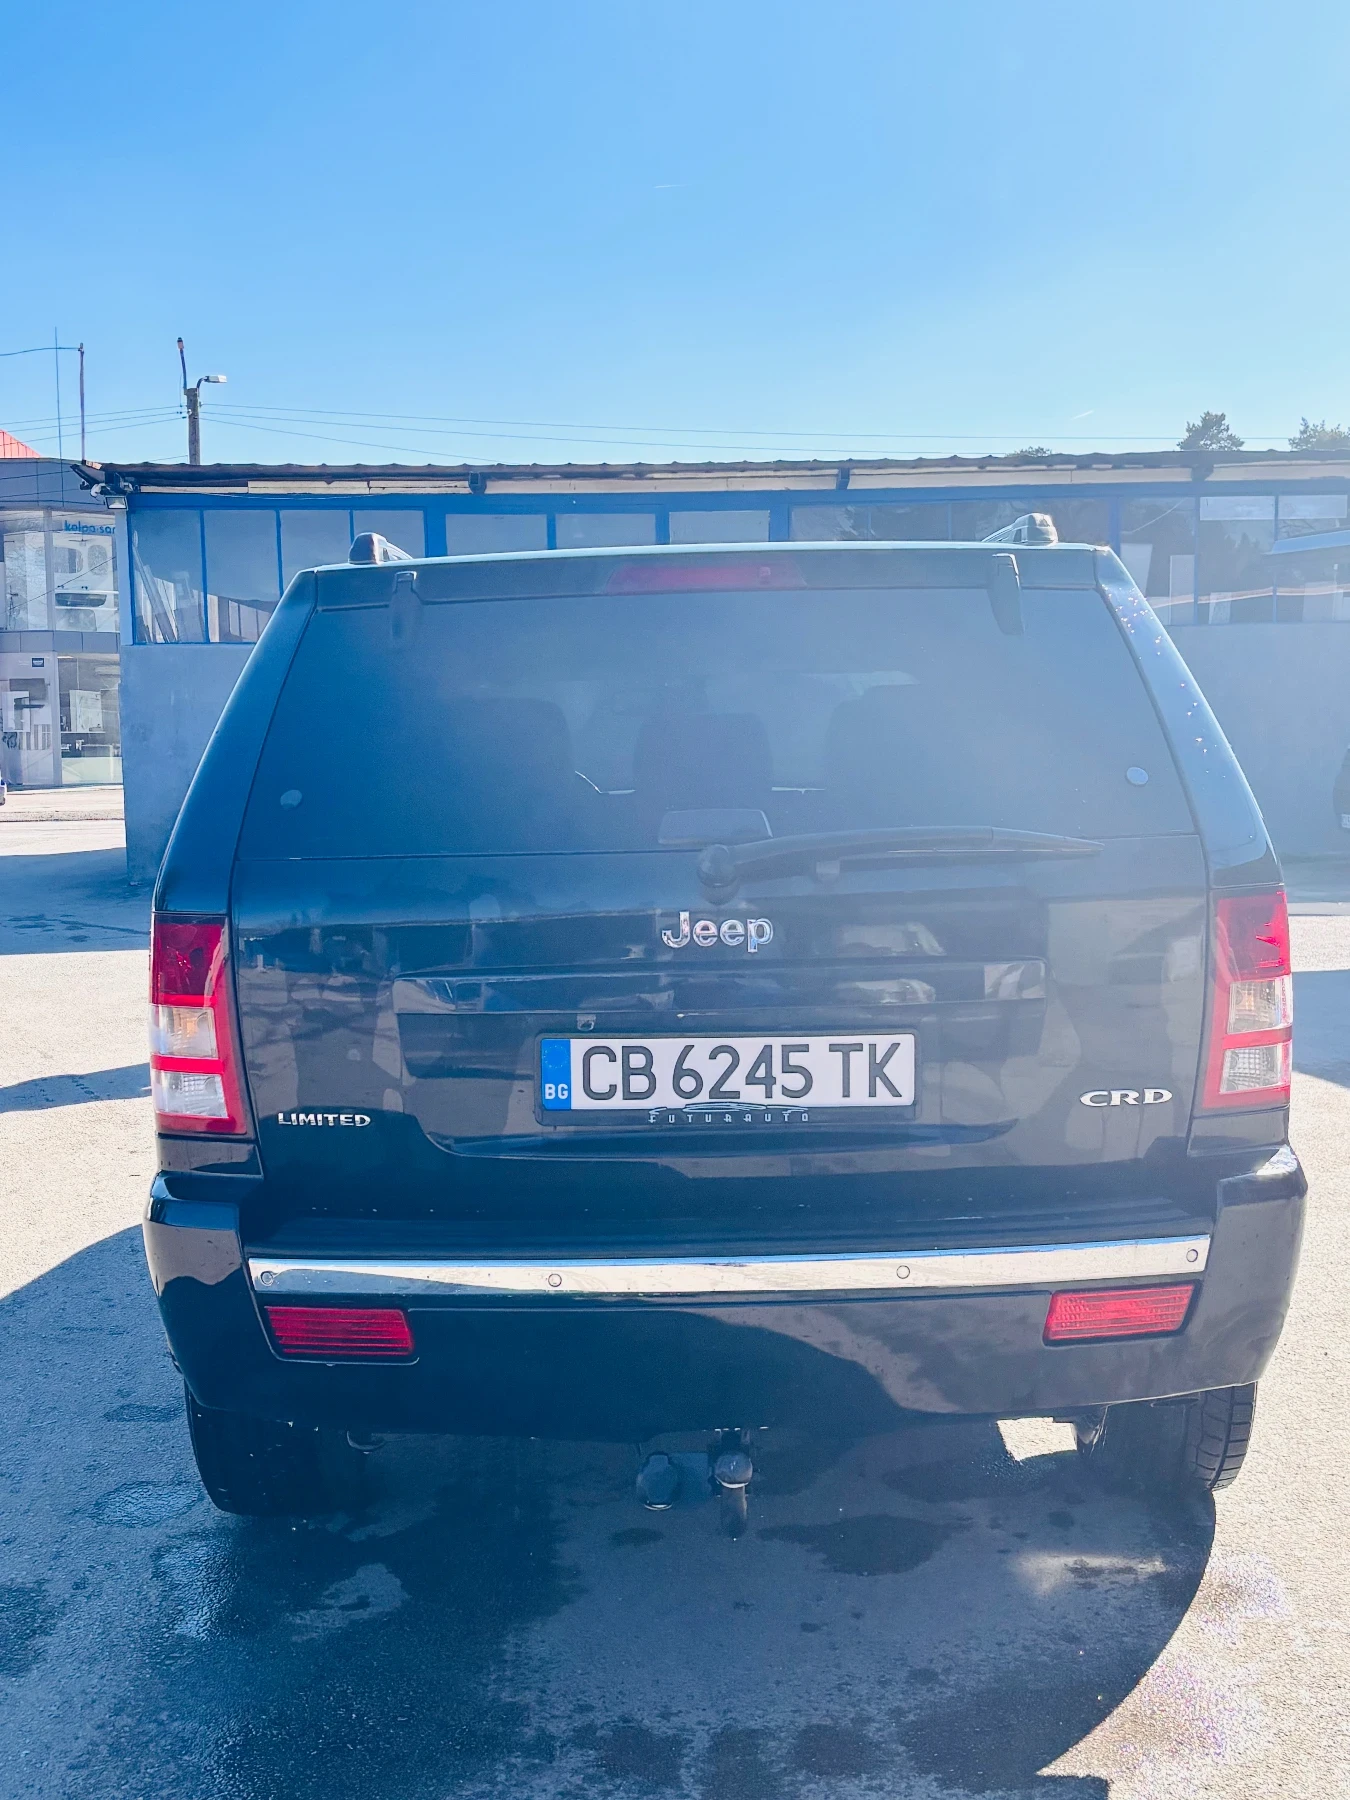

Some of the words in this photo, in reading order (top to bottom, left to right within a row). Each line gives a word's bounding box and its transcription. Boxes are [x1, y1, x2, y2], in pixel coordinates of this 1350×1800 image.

[661, 911, 773, 952] Jeep
[582, 1045, 656, 1100] CB
[672, 1045, 813, 1099] 6245
[829, 1042, 902, 1098] TK
[544, 1084, 569, 1100] BG
[1080, 1088, 1173, 1107] CRD
[277, 1113, 371, 1127] LIMITED
